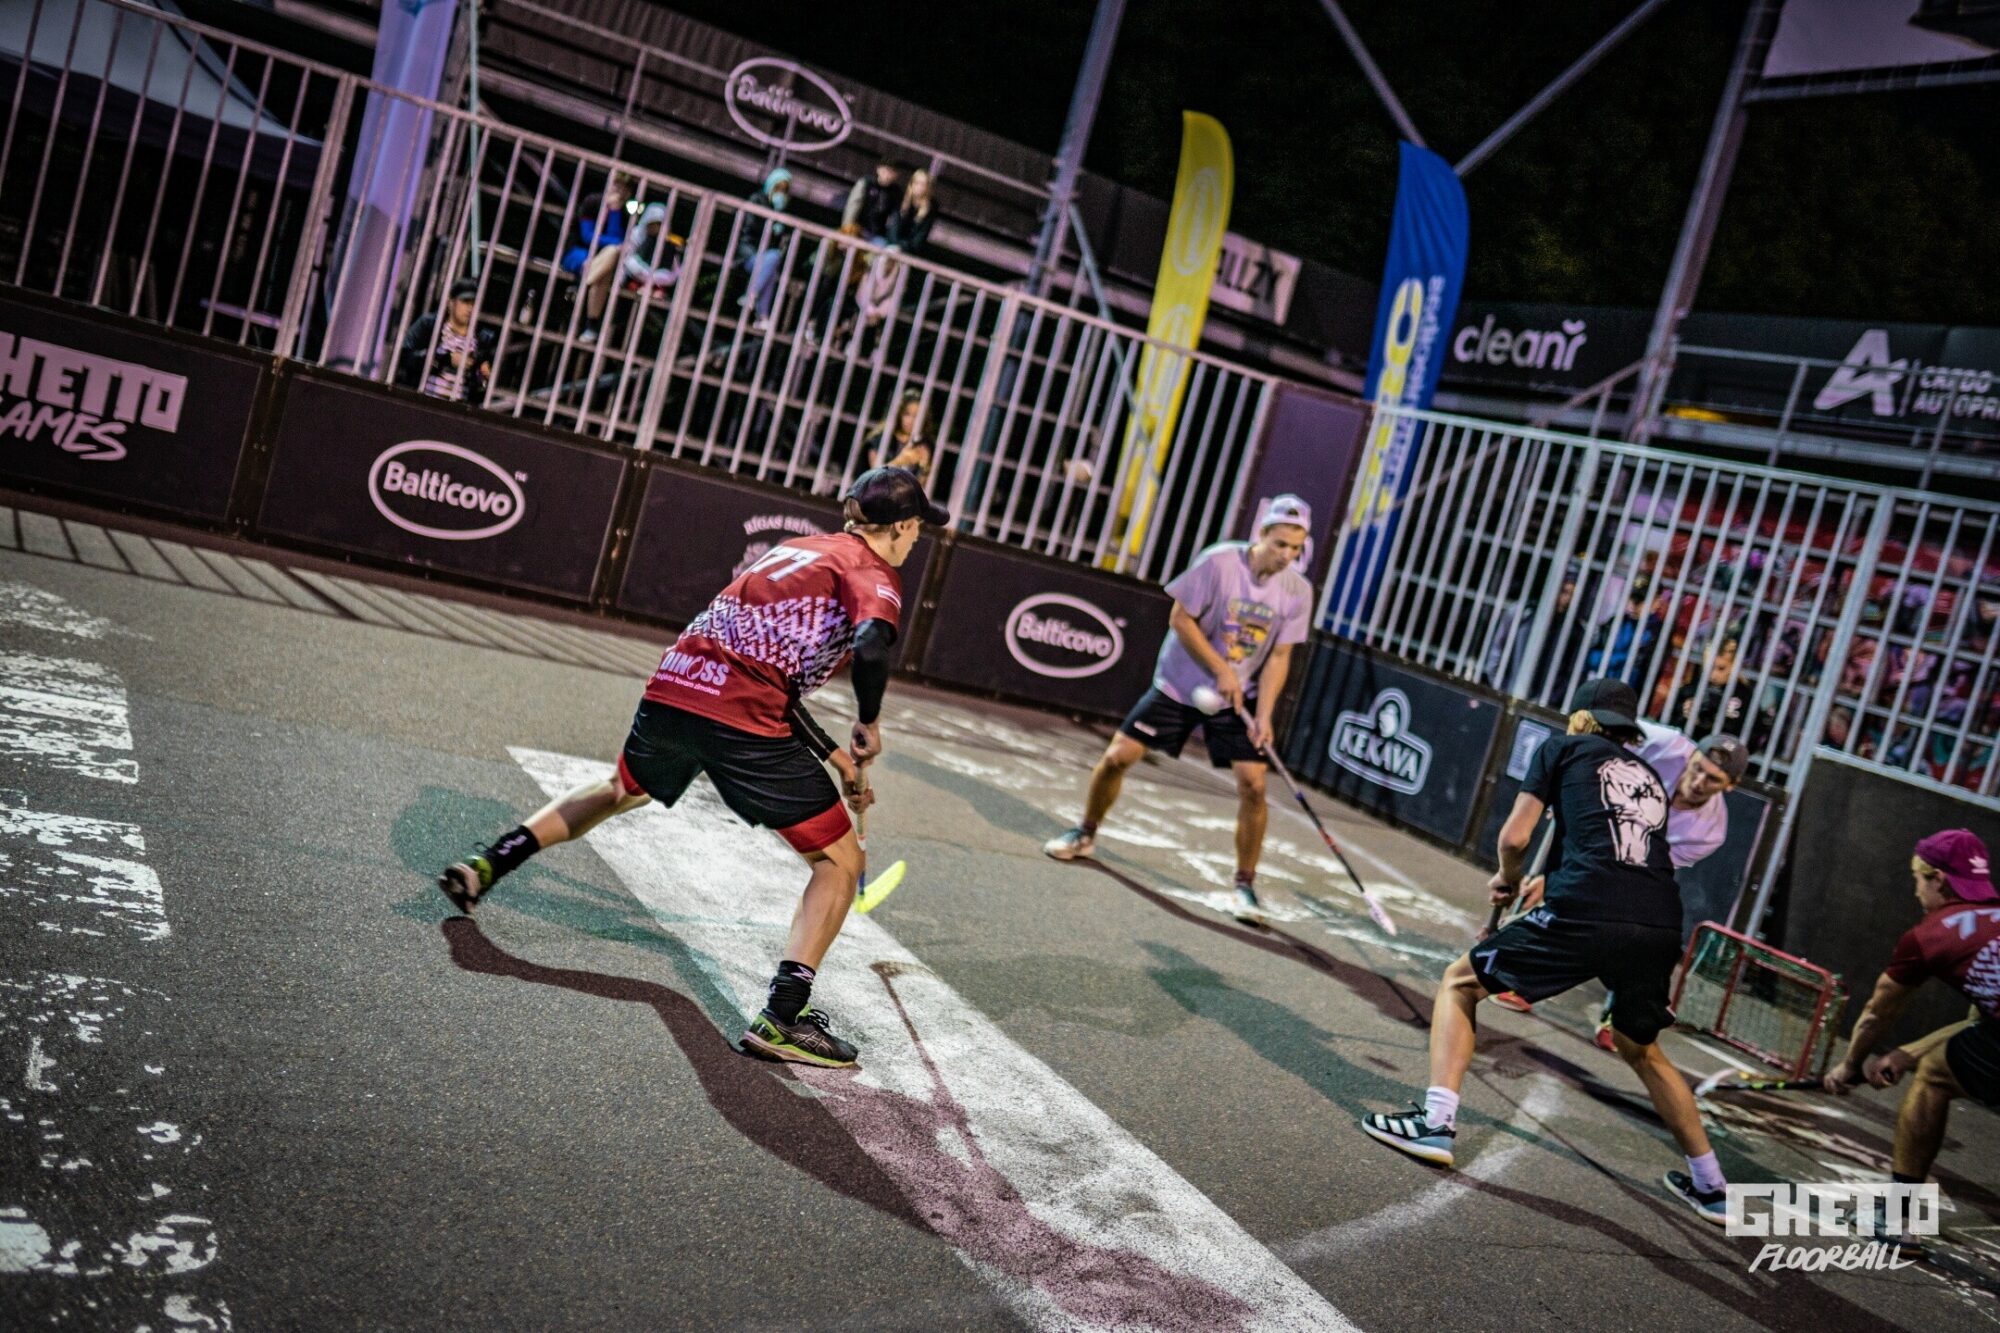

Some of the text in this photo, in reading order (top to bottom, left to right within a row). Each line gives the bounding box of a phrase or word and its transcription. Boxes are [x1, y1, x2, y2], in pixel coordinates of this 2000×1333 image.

[0, 331, 188, 434] HETTO
[0, 398, 128, 461] AMES
[383, 460, 513, 517] Balticovo
[1017, 611, 1113, 658] Balticovo
[659, 651, 730, 687] DINOSS
